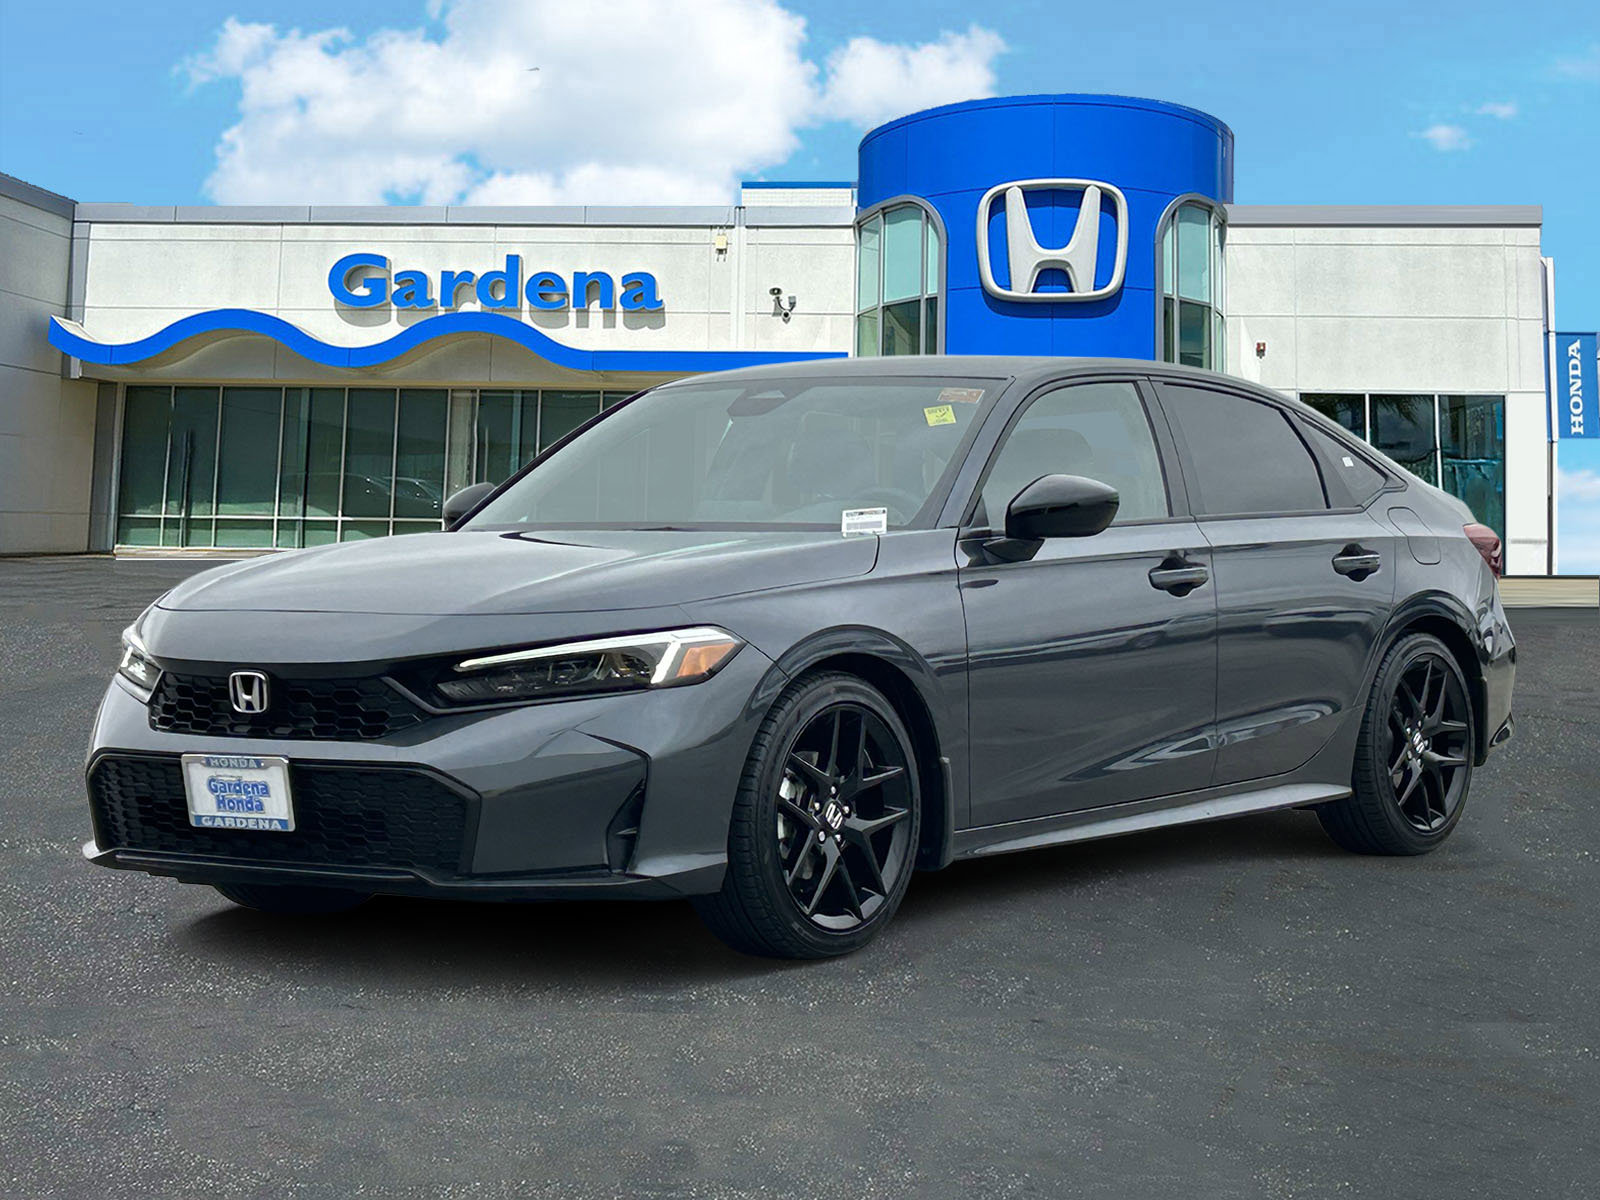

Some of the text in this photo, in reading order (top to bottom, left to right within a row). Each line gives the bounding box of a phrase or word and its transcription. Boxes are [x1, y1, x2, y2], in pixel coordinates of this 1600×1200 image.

[328, 253, 664, 310] Gardena
[1567, 338, 1584, 435] HONDA
[209, 757, 258, 769] HONDA
[207, 776, 270, 797] Gardena
[215, 795, 264, 813] Honda
[201, 816, 282, 830] GARDENA
